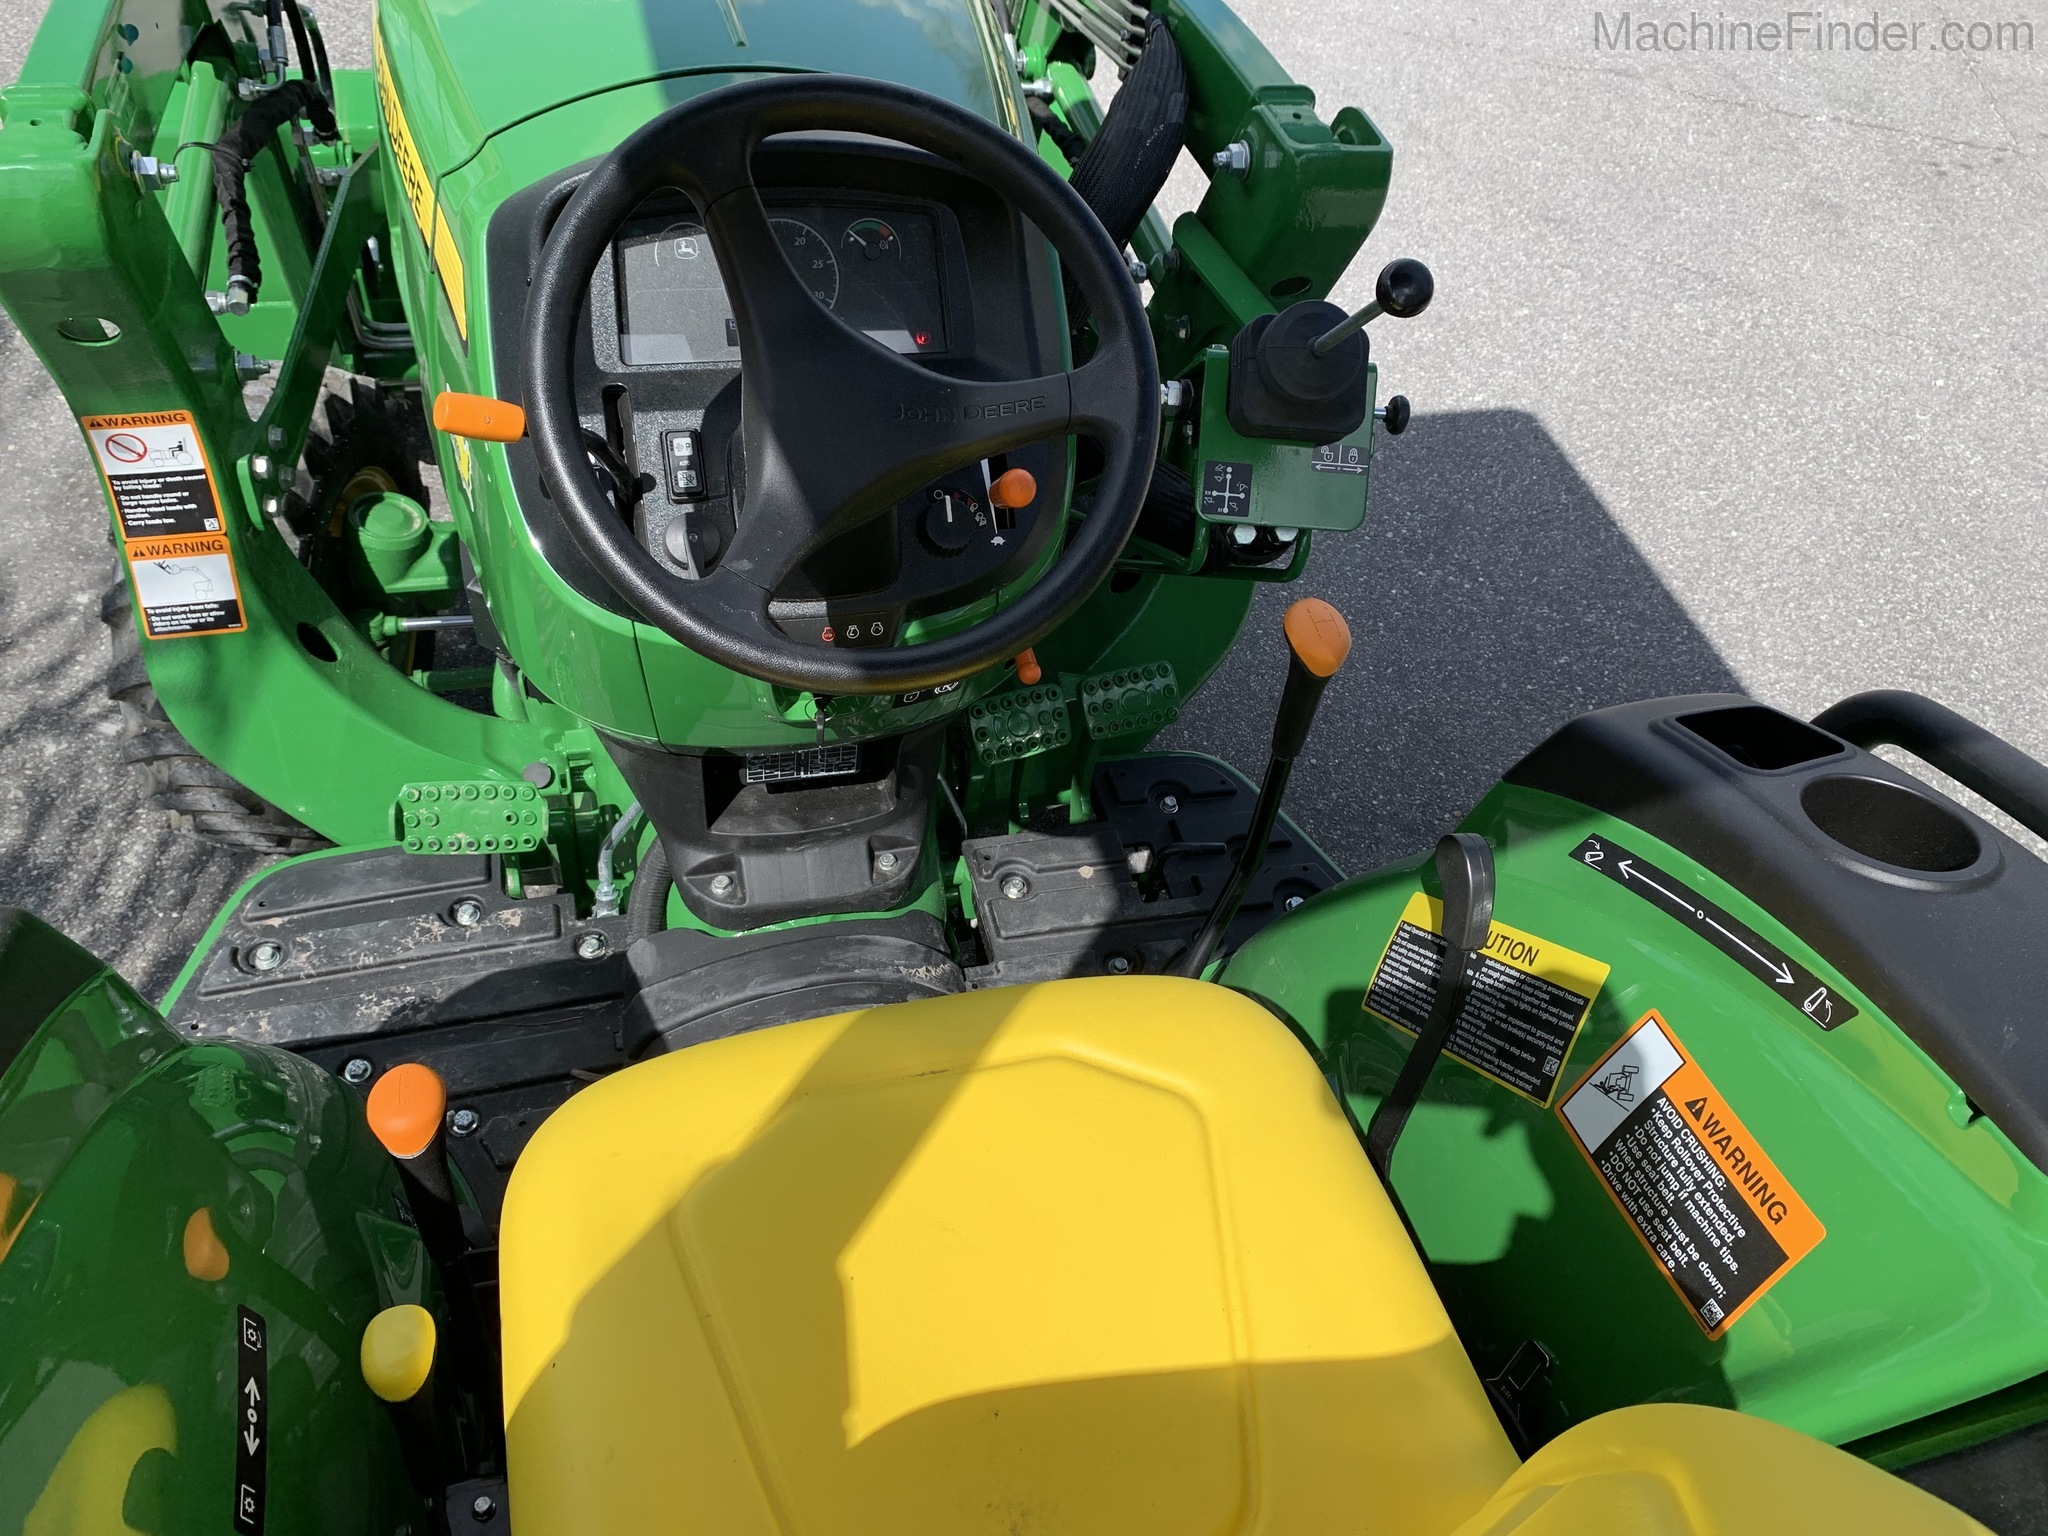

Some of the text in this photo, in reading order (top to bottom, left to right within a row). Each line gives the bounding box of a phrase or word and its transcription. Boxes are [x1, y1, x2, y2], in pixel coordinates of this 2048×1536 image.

[794, 237, 806, 246] 20
[812, 260, 824, 269] 25
[103, 413, 186, 426] WARNING
[962, 396, 1046, 420] DEERE
[146, 539, 223, 555] WARNING
[1485, 931, 1540, 966] UTION
[1641, 1159, 1659, 1182] seat
[1657, 1180, 1674, 1206] belt.
[1644, 1119, 1735, 1246] Structure fully extended.
[1656, 1097, 1726, 1190] AVOID CRUSHING:
[1703, 1113, 1786, 1223] WARNING
[1615, 1138, 1635, 1169] When
[1634, 1170, 1668, 1216] structure
[1666, 1216, 1689, 1245] must
[1686, 1243, 1699, 1261] be
[1698, 1261, 1726, 1298] down;
[1622, 1171, 1641, 1195] NOT
[1638, 1196, 1653, 1217] use
[1652, 1217, 1672, 1242] seat
[1669, 1240, 1688, 1268] belt.
[1645, 1145, 1662, 1164] not
[1657, 1161, 1679, 1190] jump
[1677, 1188, 1689, 1200] if
[1684, 1200, 1720, 1247] machine
[1719, 1246, 1738, 1274] tips.
[1671, 1137, 1705, 1181] Rollover
[1702, 1180, 1745, 1237] Protective
[1621, 1191, 1637, 1215] with
[1636, 1215, 1657, 1243] extra
[1656, 1243, 1675, 1272] care.
